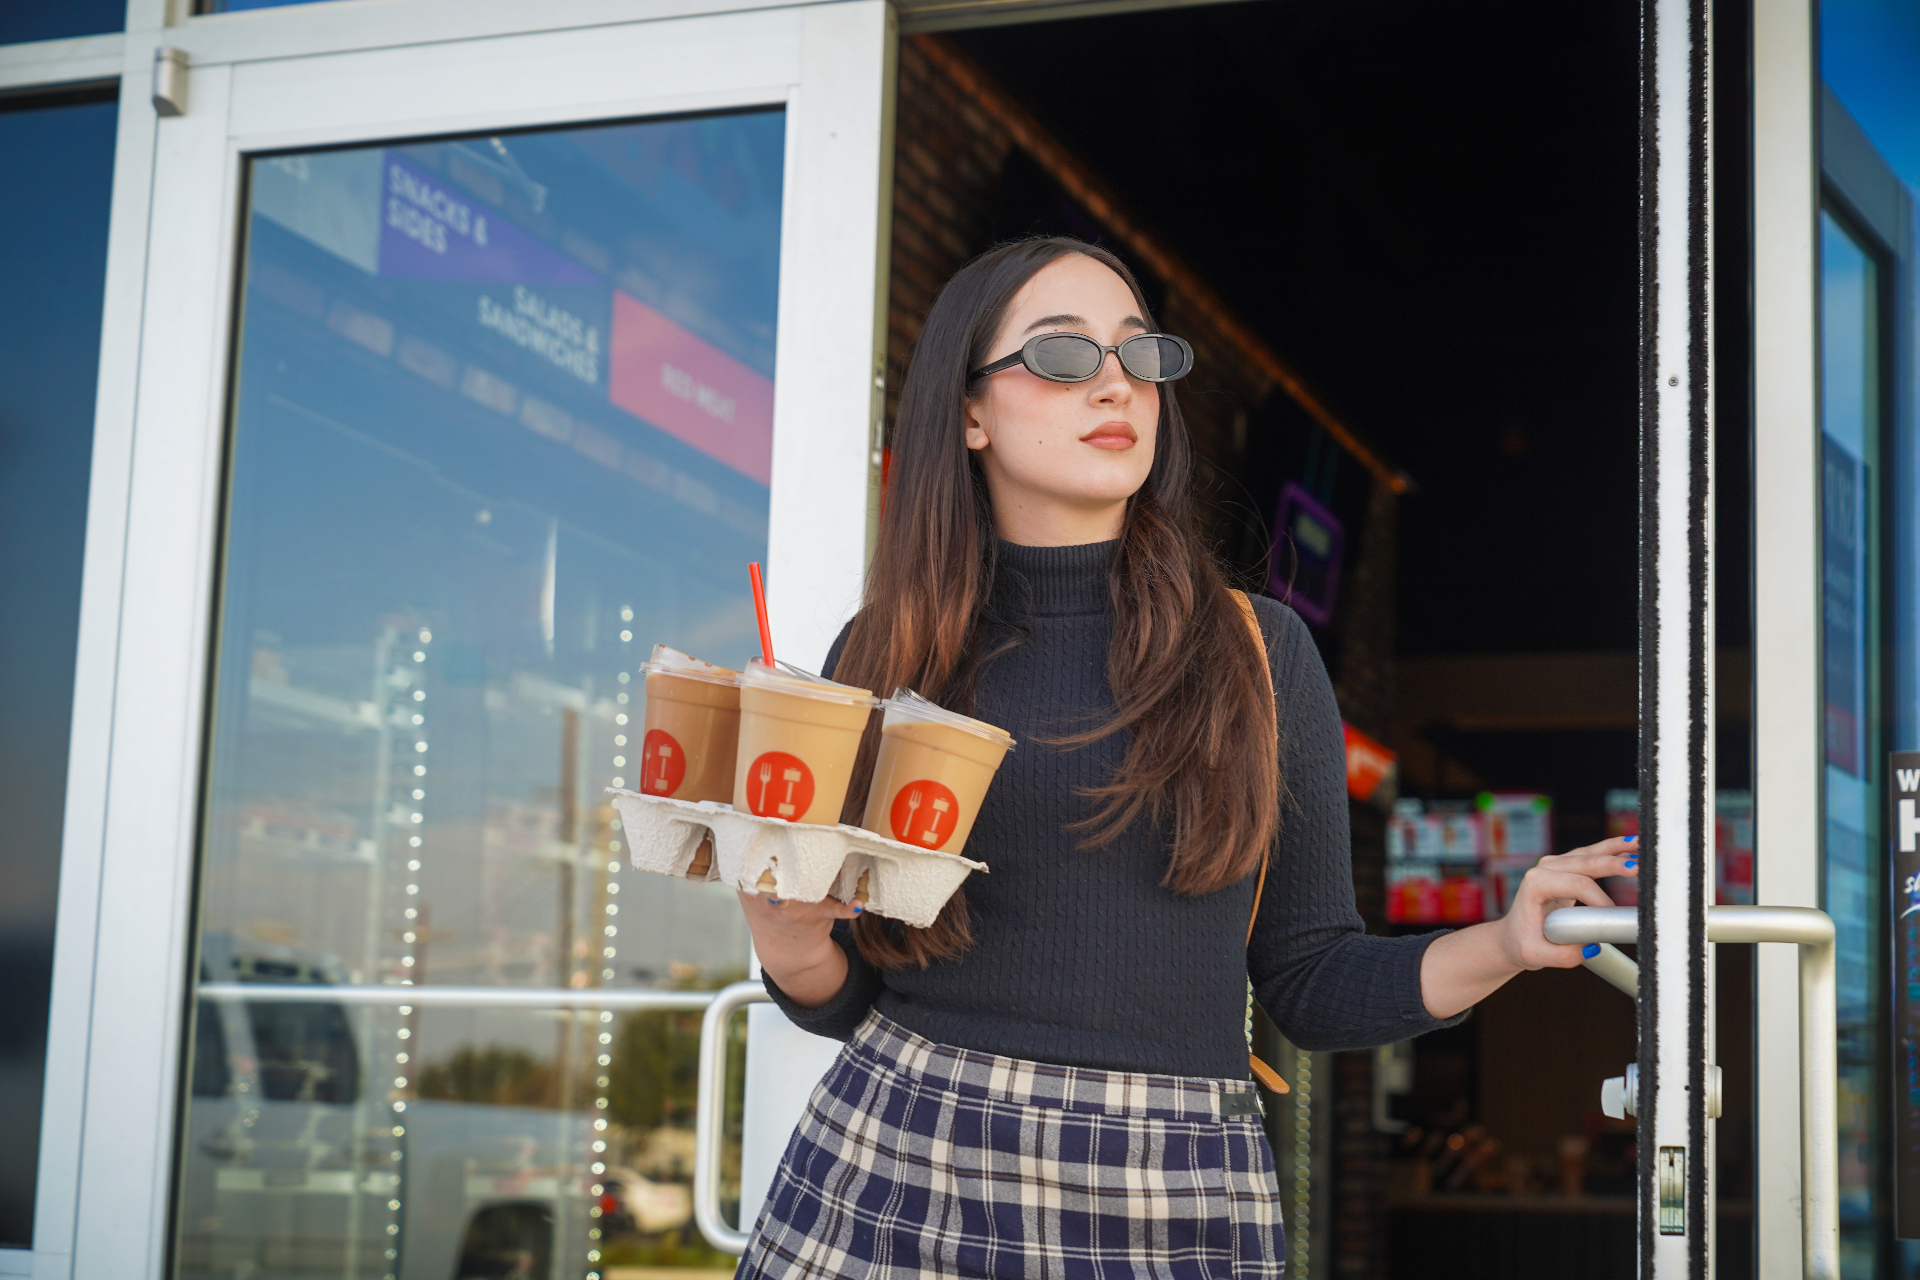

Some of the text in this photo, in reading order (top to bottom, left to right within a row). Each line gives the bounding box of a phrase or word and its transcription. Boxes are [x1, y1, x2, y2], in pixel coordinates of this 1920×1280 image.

[388, 198, 447, 253] SIDES
[389, 165, 470, 235] SNACKS
[479, 295, 598, 383] SANDWICHES
[514, 285, 583, 346] SALADS
